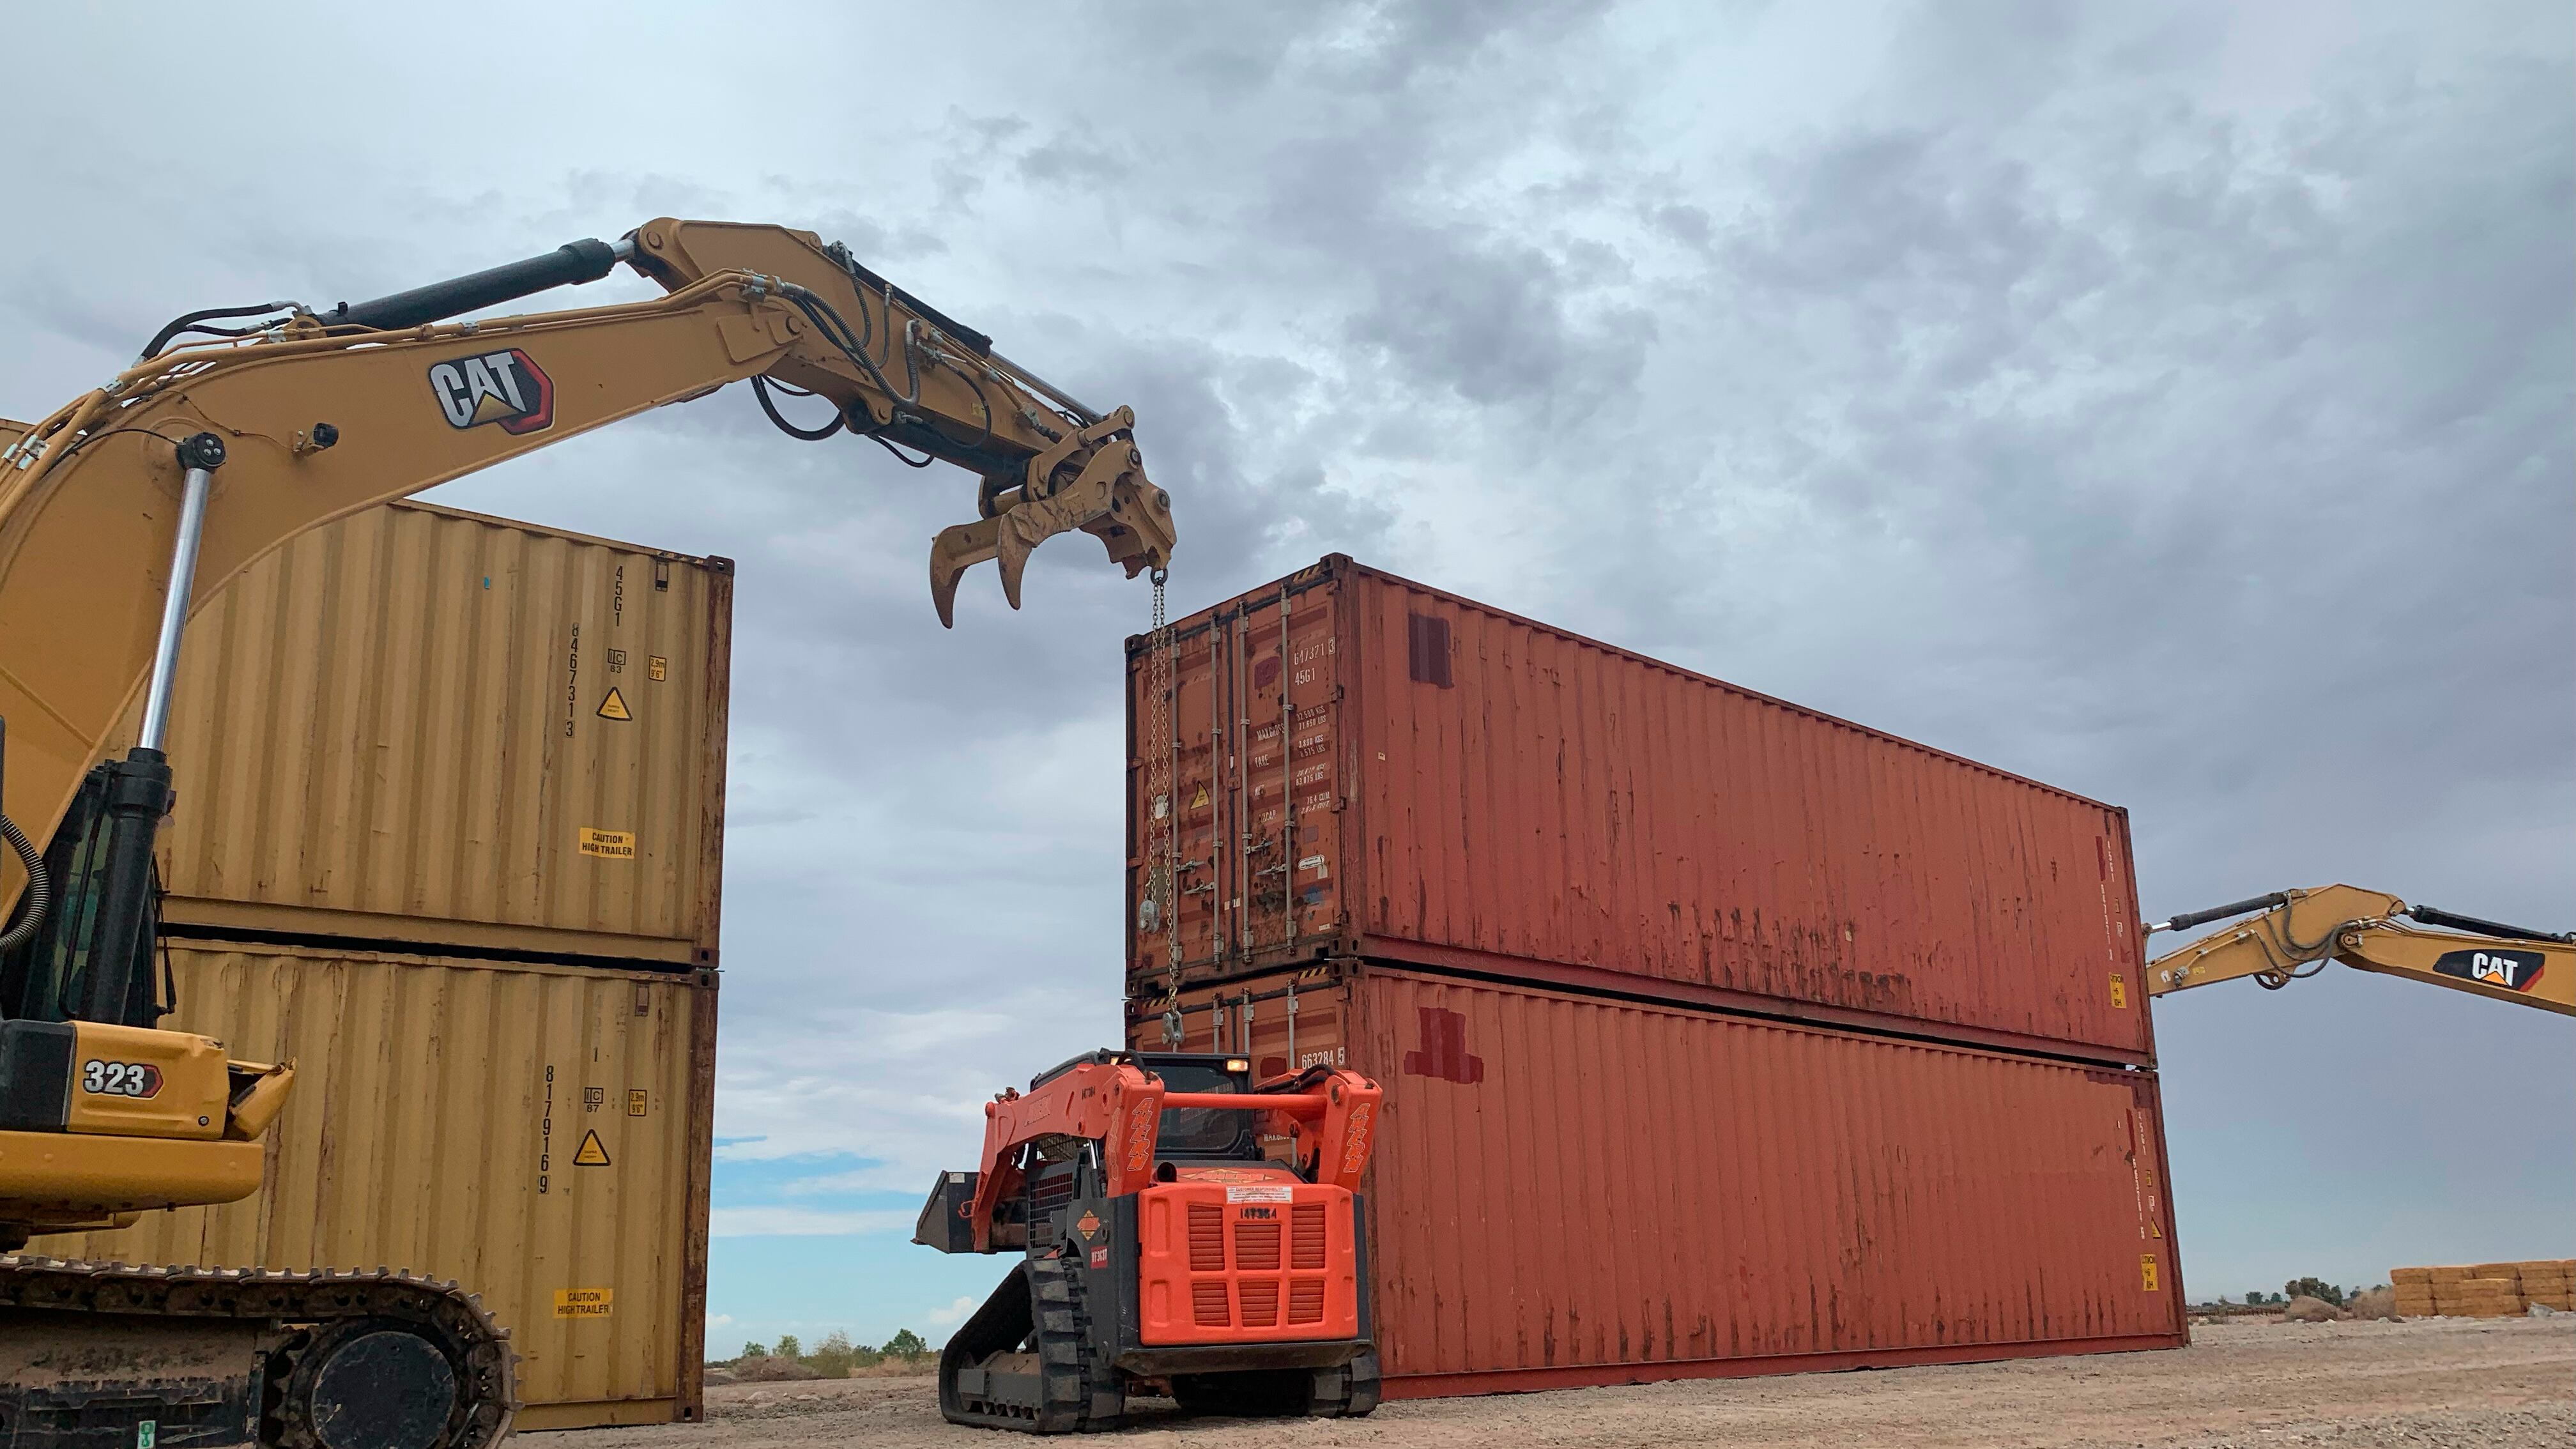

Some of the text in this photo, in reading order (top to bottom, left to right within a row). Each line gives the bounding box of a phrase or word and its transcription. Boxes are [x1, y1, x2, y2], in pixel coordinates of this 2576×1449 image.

[431, 351, 527, 427] CAT
[614, 565, 623, 627] 45G1
[1294, 643, 1324, 665] 647321
[610, 664, 622, 674] 83
[1295, 668, 1315, 686] 45G1
[1254, 754, 1269, 768] TARE
[592, 832, 624, 844] CAUTION
[582, 842, 632, 856] HIGH TRAILER
[2472, 952, 2518, 987] CAT
[1301, 1050, 1334, 1070] 663284
[84, 1061, 146, 1095] 323
[586, 1104, 600, 1113] 87
[567, 1292, 601, 1302] CAUTION
[557, 1304, 610, 1315] HIGH TRAILER
